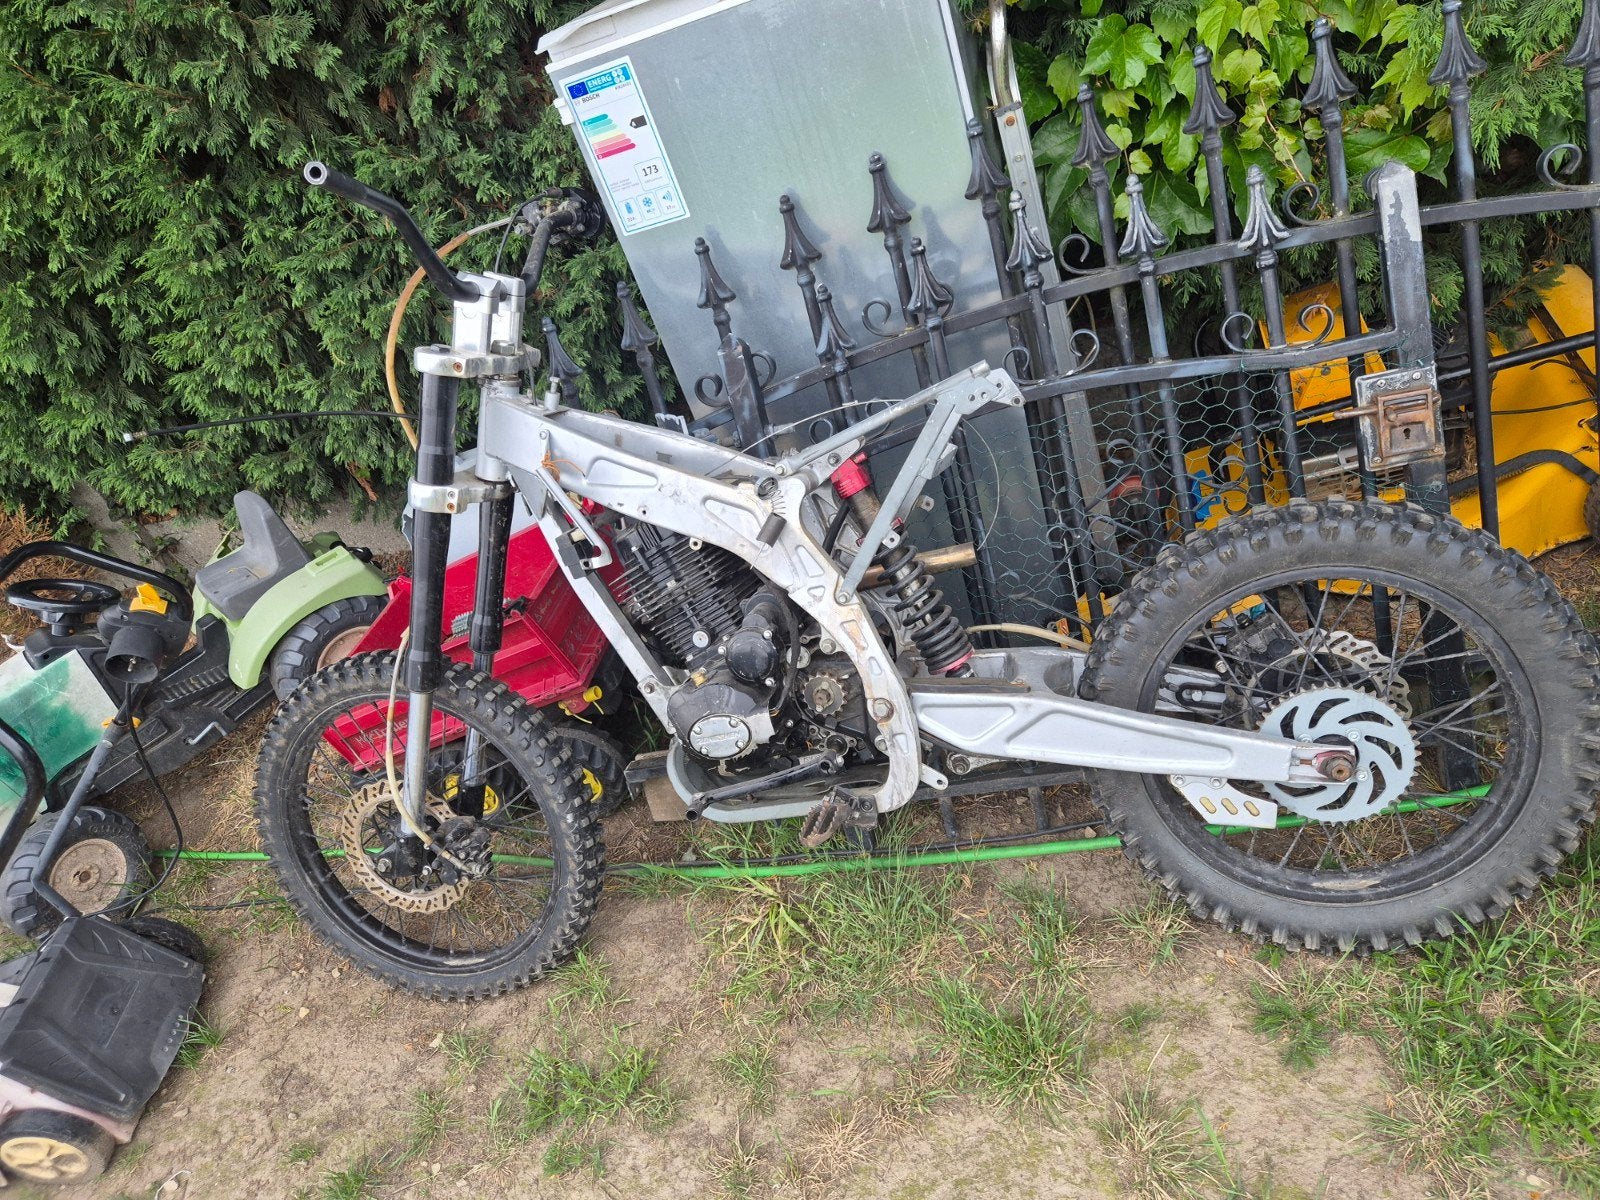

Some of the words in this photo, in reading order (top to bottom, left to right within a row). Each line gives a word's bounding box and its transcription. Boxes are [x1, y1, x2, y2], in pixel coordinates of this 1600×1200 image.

[587, 73, 613, 88] ENERG
[582, 93, 601, 103] BOSCH
[642, 164, 659, 176] 173
